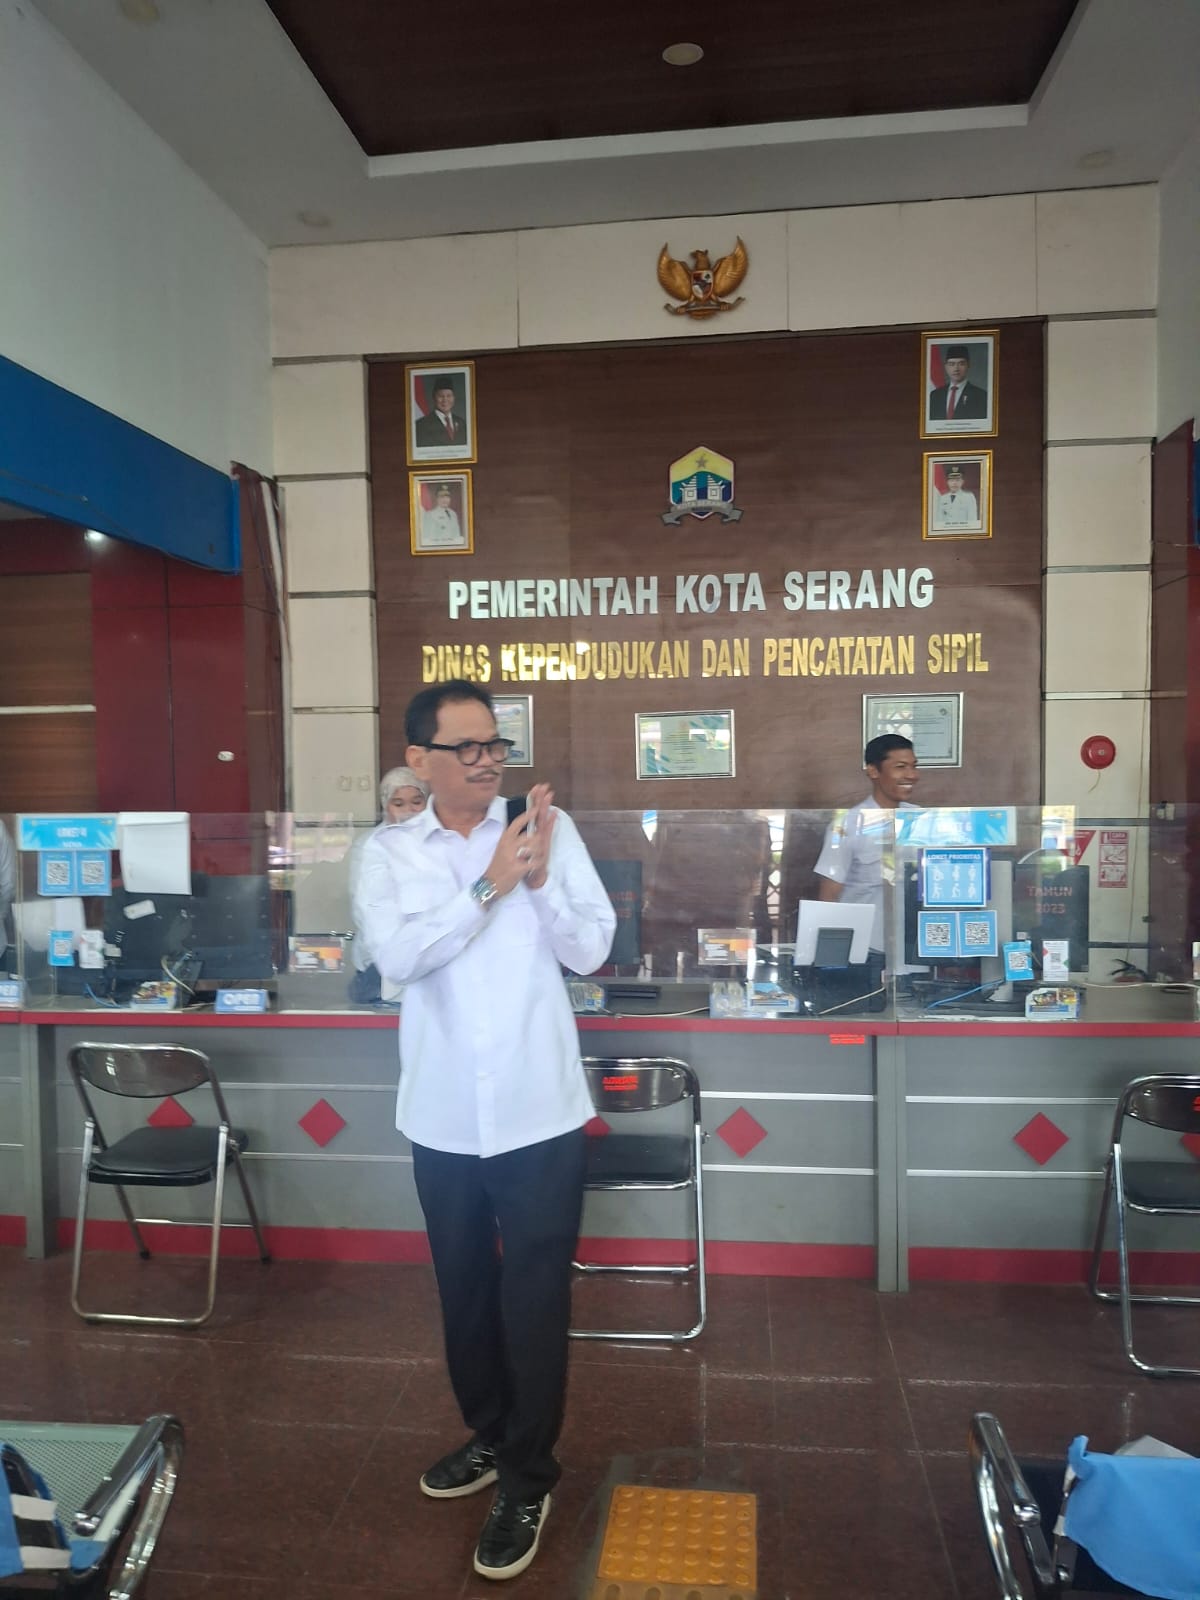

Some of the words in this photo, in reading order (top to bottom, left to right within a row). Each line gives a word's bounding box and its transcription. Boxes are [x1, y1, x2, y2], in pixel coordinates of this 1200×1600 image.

[449, 576, 658, 619] PEMERINTAH
[675, 572, 767, 613] KOTA
[783, 568, 934, 611] SERANG
[422, 644, 492, 683] DINAS
[501, 640, 689, 681] KEPENDUDUKAN
[702, 638, 749, 678] DAN
[763, 635, 915, 677] PENCATATAN
[927, 633, 989, 674] SIPIL
[1026, 886, 1073, 897] TAHUN
